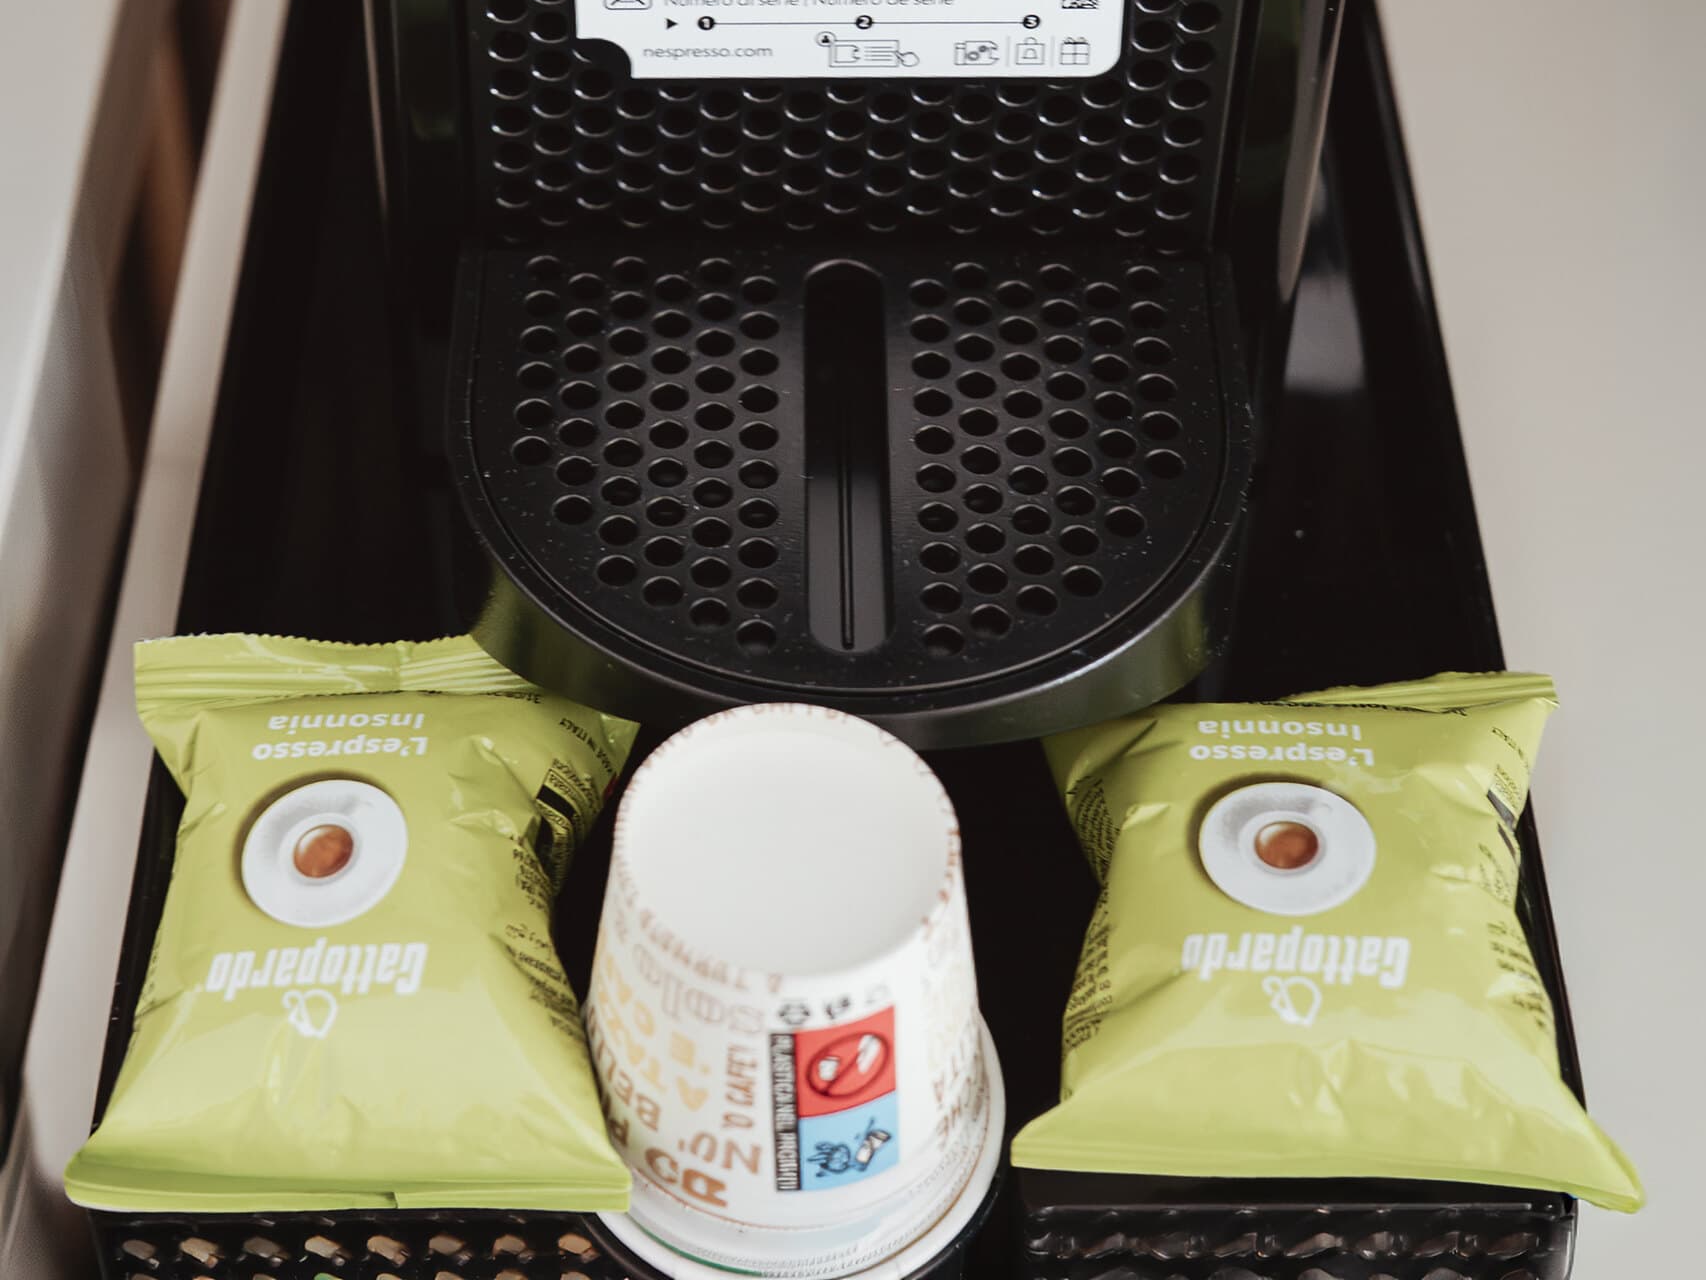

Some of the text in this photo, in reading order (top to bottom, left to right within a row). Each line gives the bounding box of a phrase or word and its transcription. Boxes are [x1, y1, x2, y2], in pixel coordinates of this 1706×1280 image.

[643, 46, 773, 61] nespresso.com
[268, 712, 426, 736] Insonnia
[1198, 719, 1362, 742] Insonnia
[205, 937, 430, 1001] Gattopardo
[1180, 927, 1411, 989] Gattopardo
